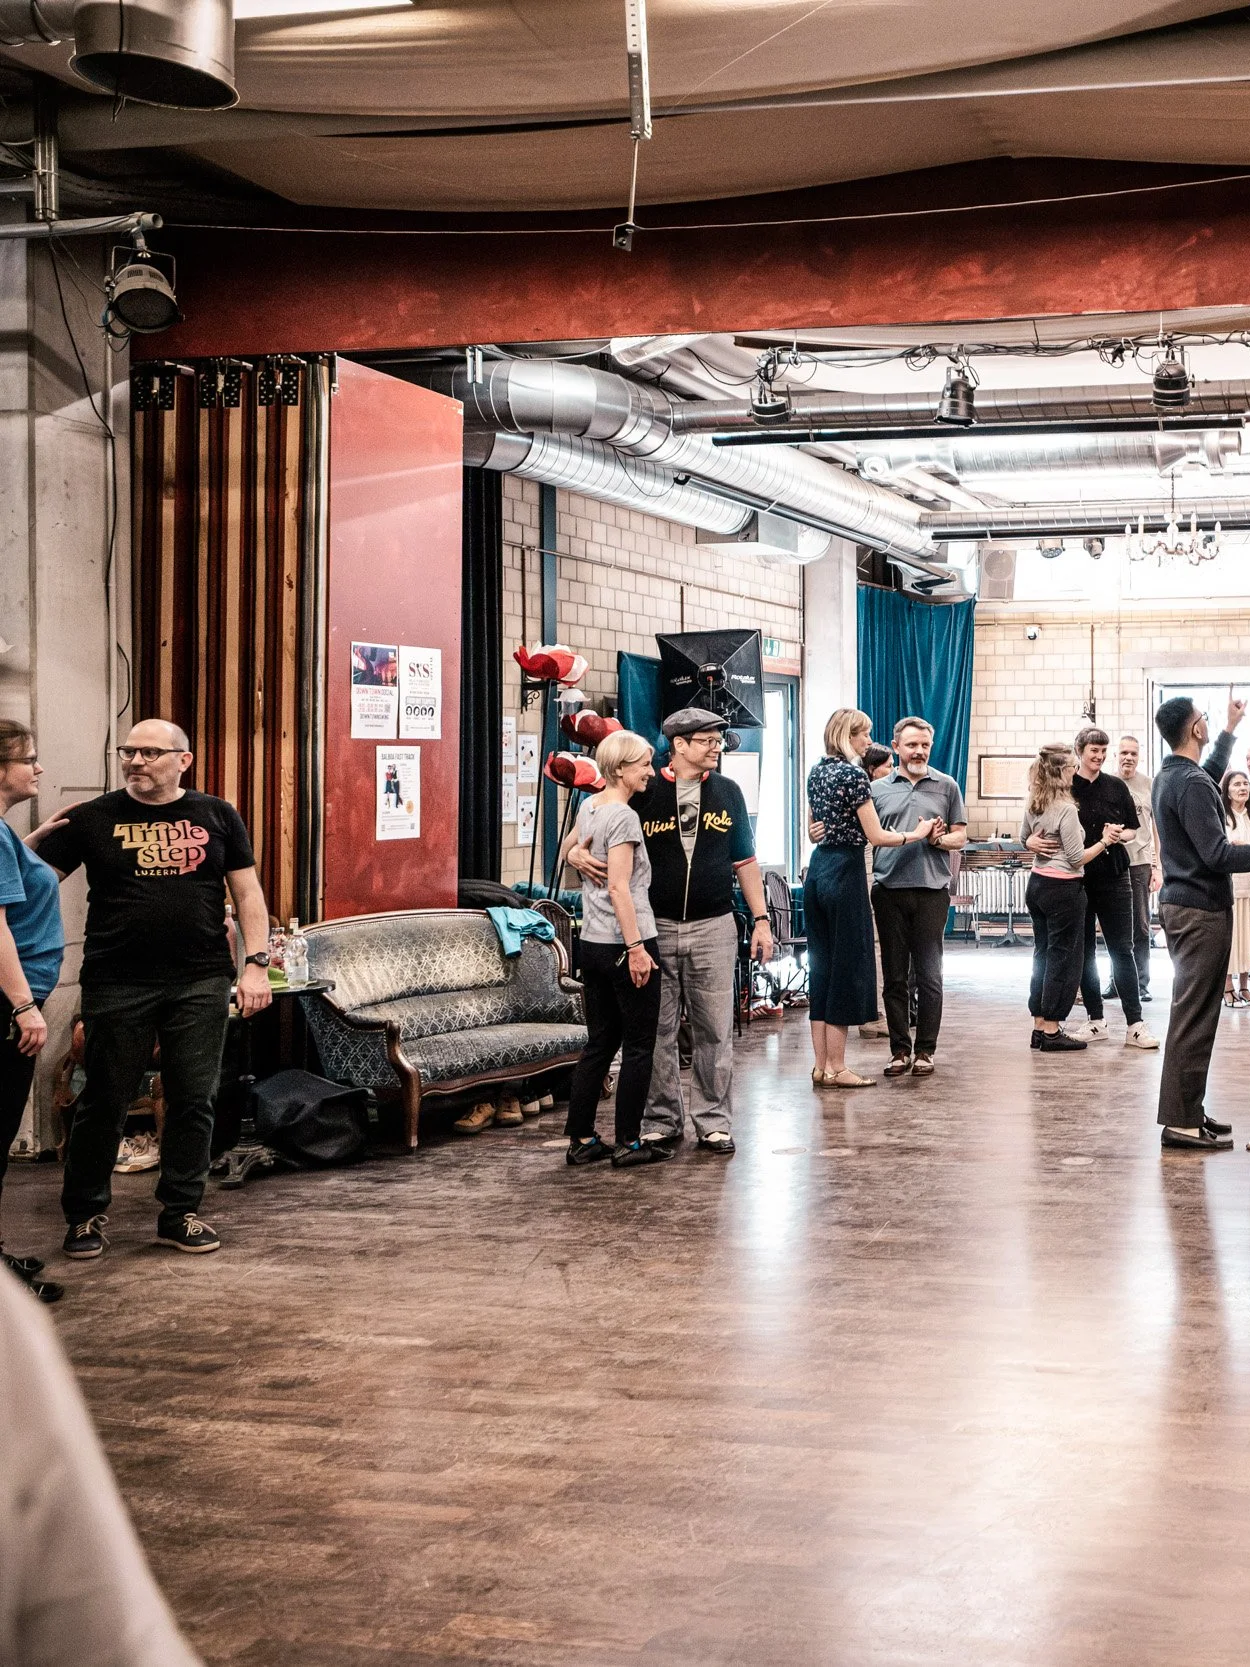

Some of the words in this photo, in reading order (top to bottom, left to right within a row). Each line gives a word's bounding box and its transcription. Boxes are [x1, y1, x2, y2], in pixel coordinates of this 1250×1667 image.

[119, 822, 204, 846] Triple
[643, 816, 676, 837] Vivi
[703, 810, 733, 833] Kola
[142, 844, 201, 867] step
[134, 869, 178, 877] LUZERN
